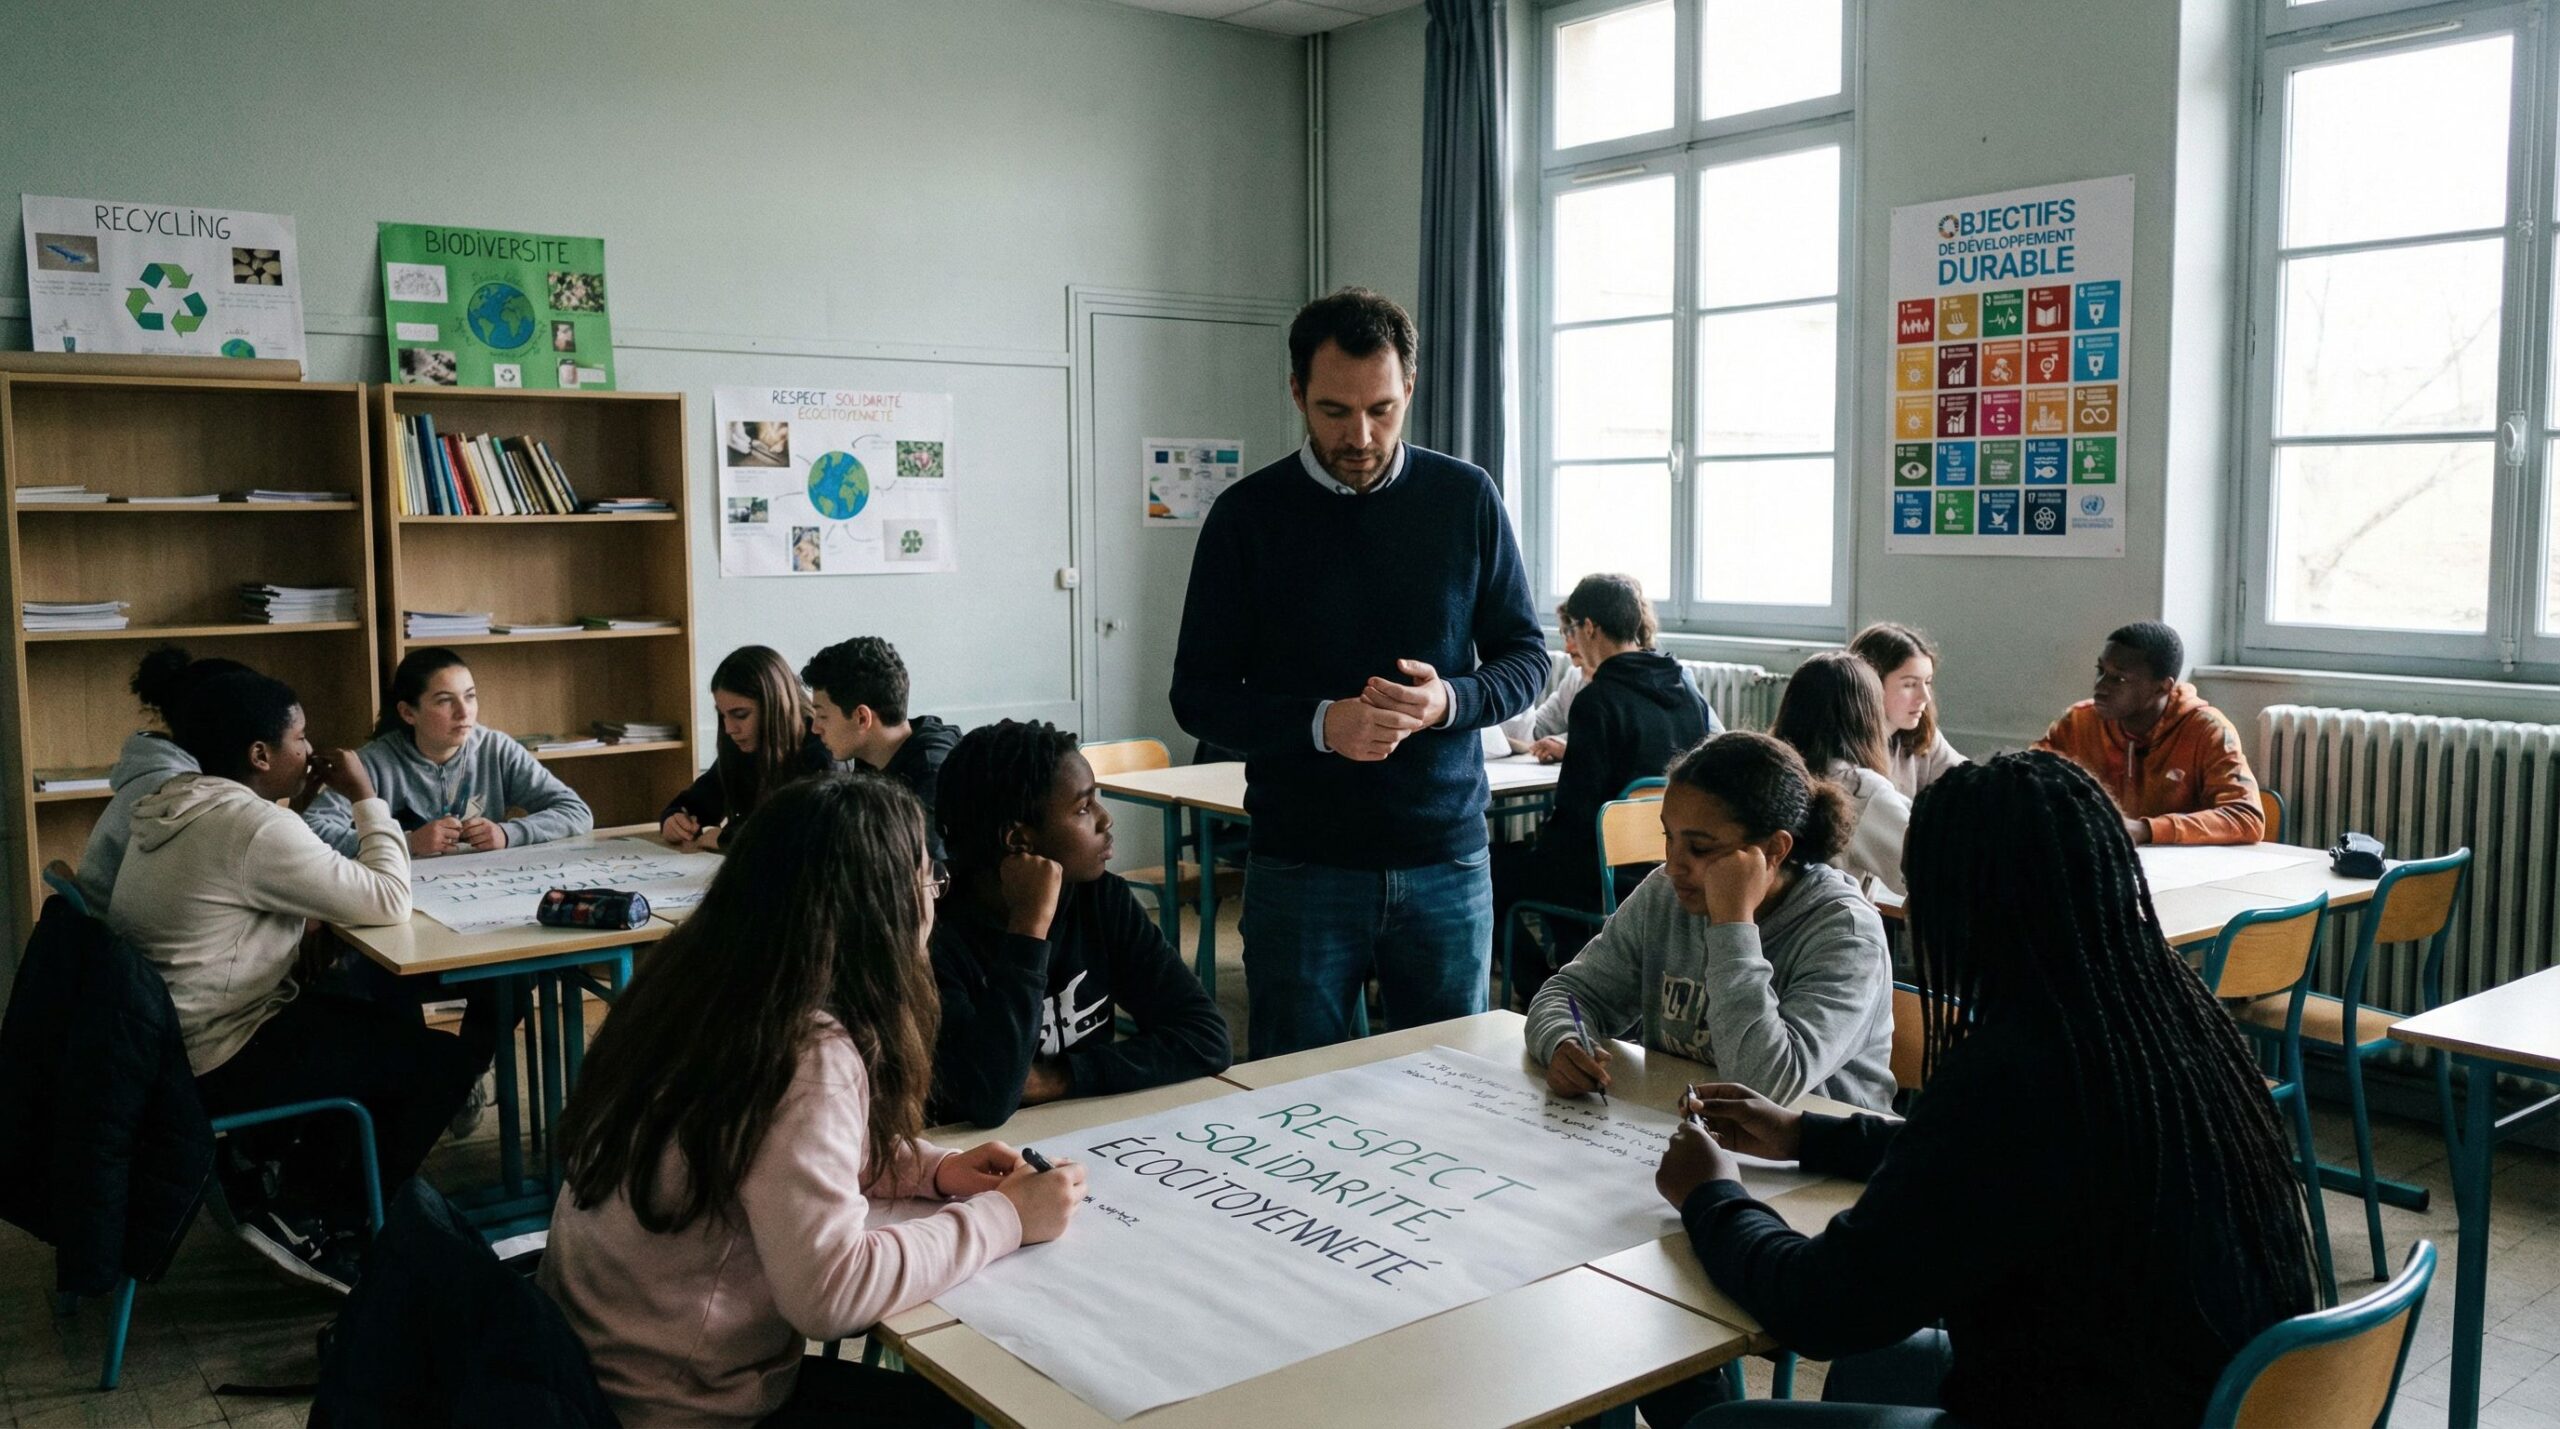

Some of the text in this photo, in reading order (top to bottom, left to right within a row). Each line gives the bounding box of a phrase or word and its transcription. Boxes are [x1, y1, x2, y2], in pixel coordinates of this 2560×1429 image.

[95, 204, 232, 240] RECYCLING
[1938, 198, 2076, 239] OBJECTIFS
[425, 228, 570, 265] BIODIVERSITE
[1938, 228, 2076, 256] DE DÉVELOPPEMENT
[1938, 245, 2075, 286] DURABLE
[1984, 295, 1992, 306] 3
[772, 390, 827, 406] RESPECT
[1258, 1102, 1537, 1200] RESPECT
[1176, 1122, 1465, 1242] SOLIDARITÉ,
